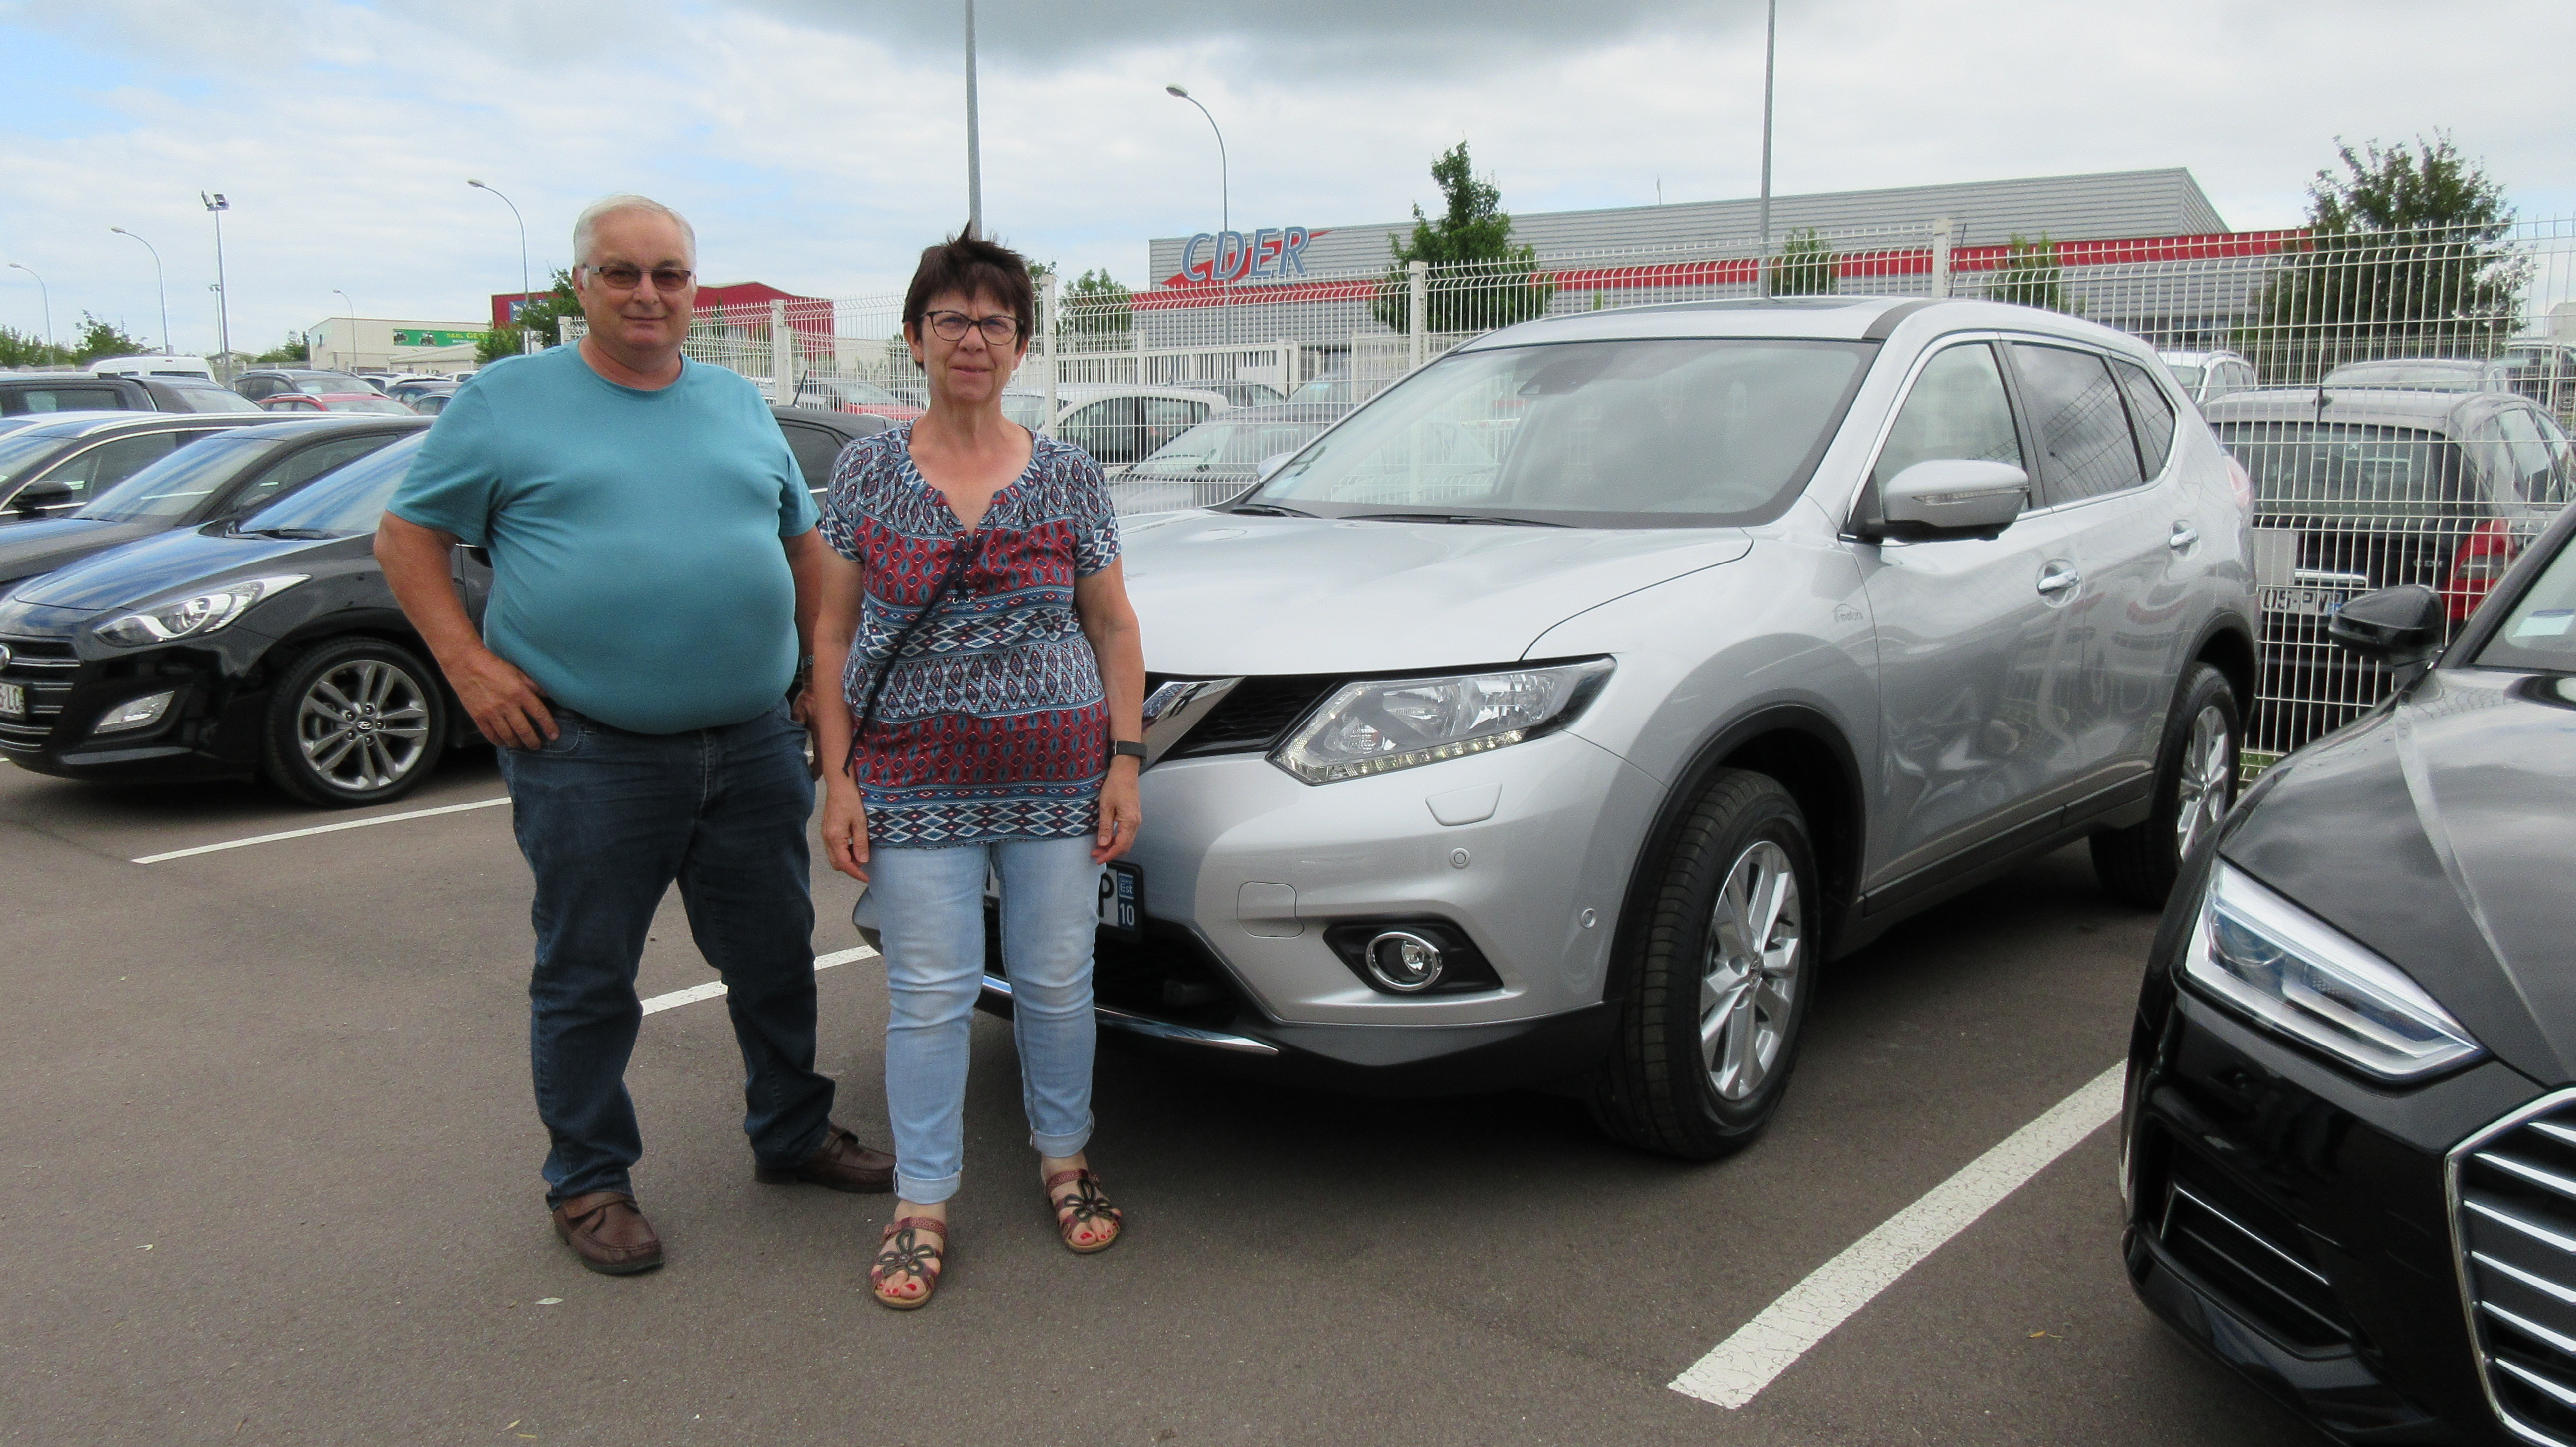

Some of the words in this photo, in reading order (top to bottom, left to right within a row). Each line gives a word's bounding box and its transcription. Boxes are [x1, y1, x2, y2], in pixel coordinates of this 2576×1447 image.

[1181, 226, 1309, 282] CDER
[1120, 883, 1133, 894] Est
[1120, 903, 1135, 926] 10
